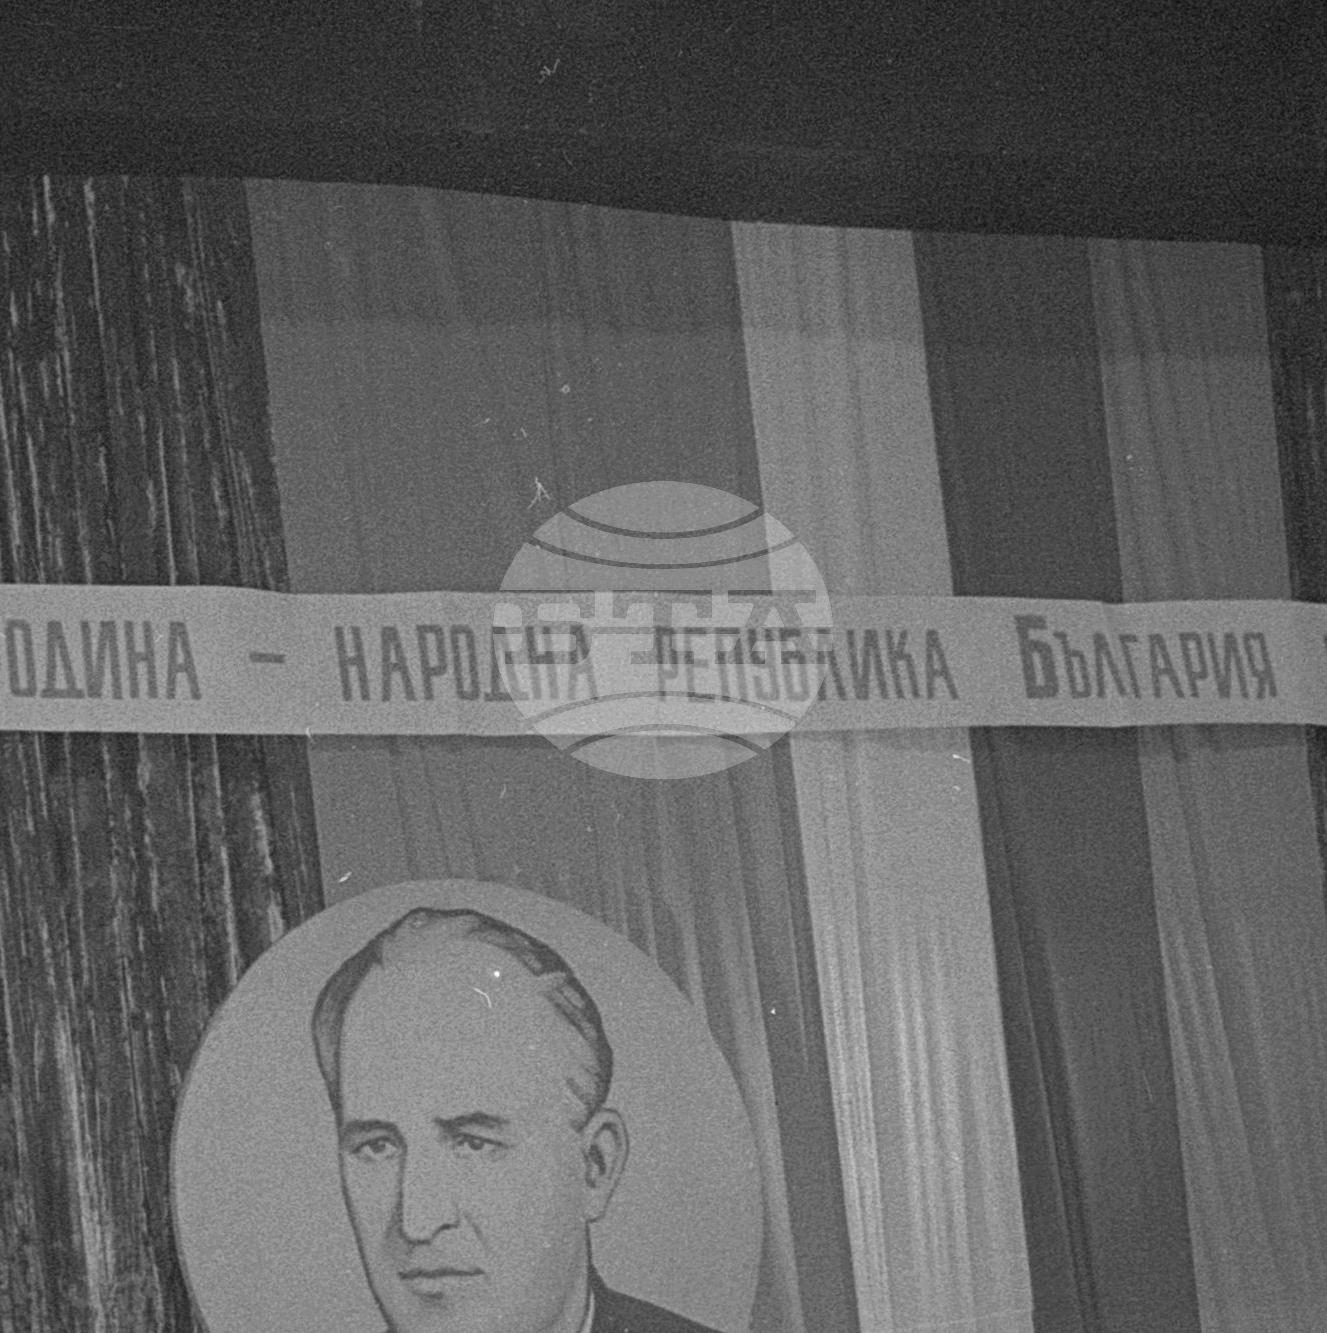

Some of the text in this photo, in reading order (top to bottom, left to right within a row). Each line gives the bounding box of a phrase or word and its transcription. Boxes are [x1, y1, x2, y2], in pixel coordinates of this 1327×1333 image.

[333, 623, 600, 703] НАРОДНА
[653, 626, 959, 702] РЕПУБЛИКА
[1013, 614, 1278, 699] БЪЛГАРИЯ
